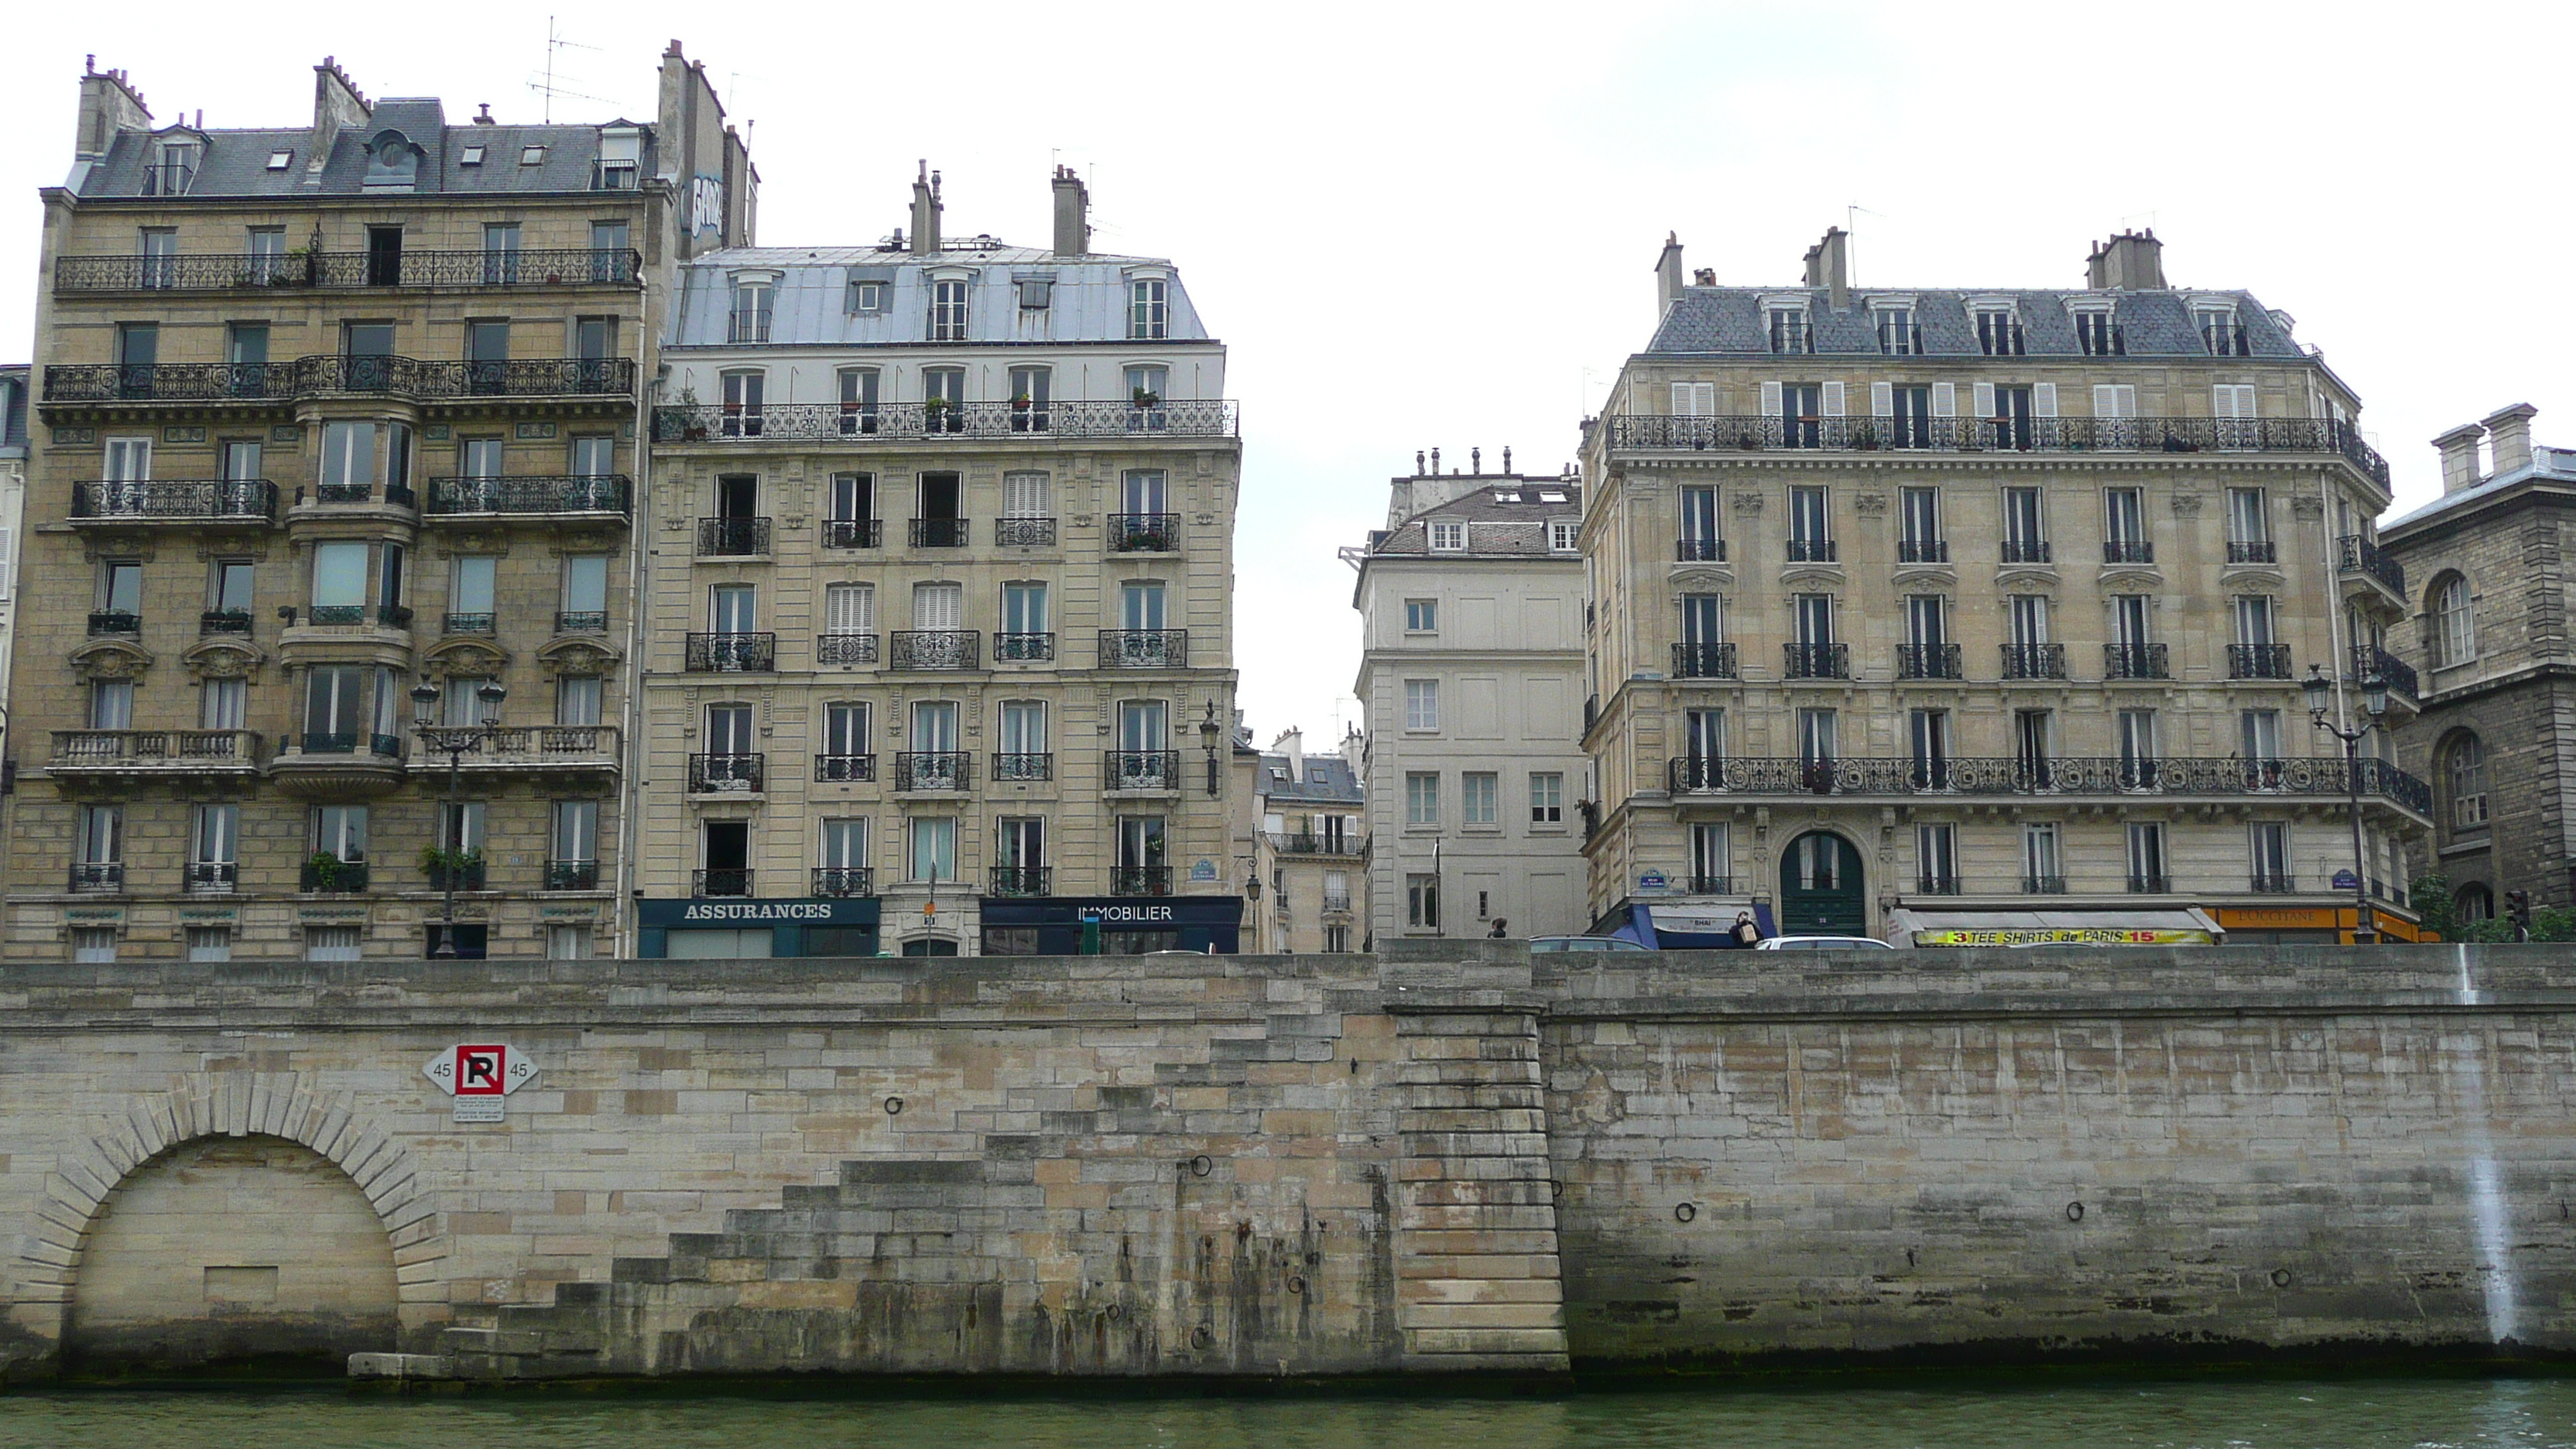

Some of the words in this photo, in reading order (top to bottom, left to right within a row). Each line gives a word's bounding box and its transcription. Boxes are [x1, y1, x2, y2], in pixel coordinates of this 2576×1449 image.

[684, 904, 831, 919] ASSURANCES
[1078, 906, 1172, 920] IMMOBILIER
[1953, 933, 1967, 943] 3
[1971, 932, 1997, 943] TEE
[2002, 931, 2054, 943] SHIRTS
[2060, 931, 2078, 942] de
[2083, 930, 2123, 941] PARIS
[433, 1064, 450, 1077] 45
[468, 1057, 493, 1084] P
[510, 1064, 527, 1077] 45
